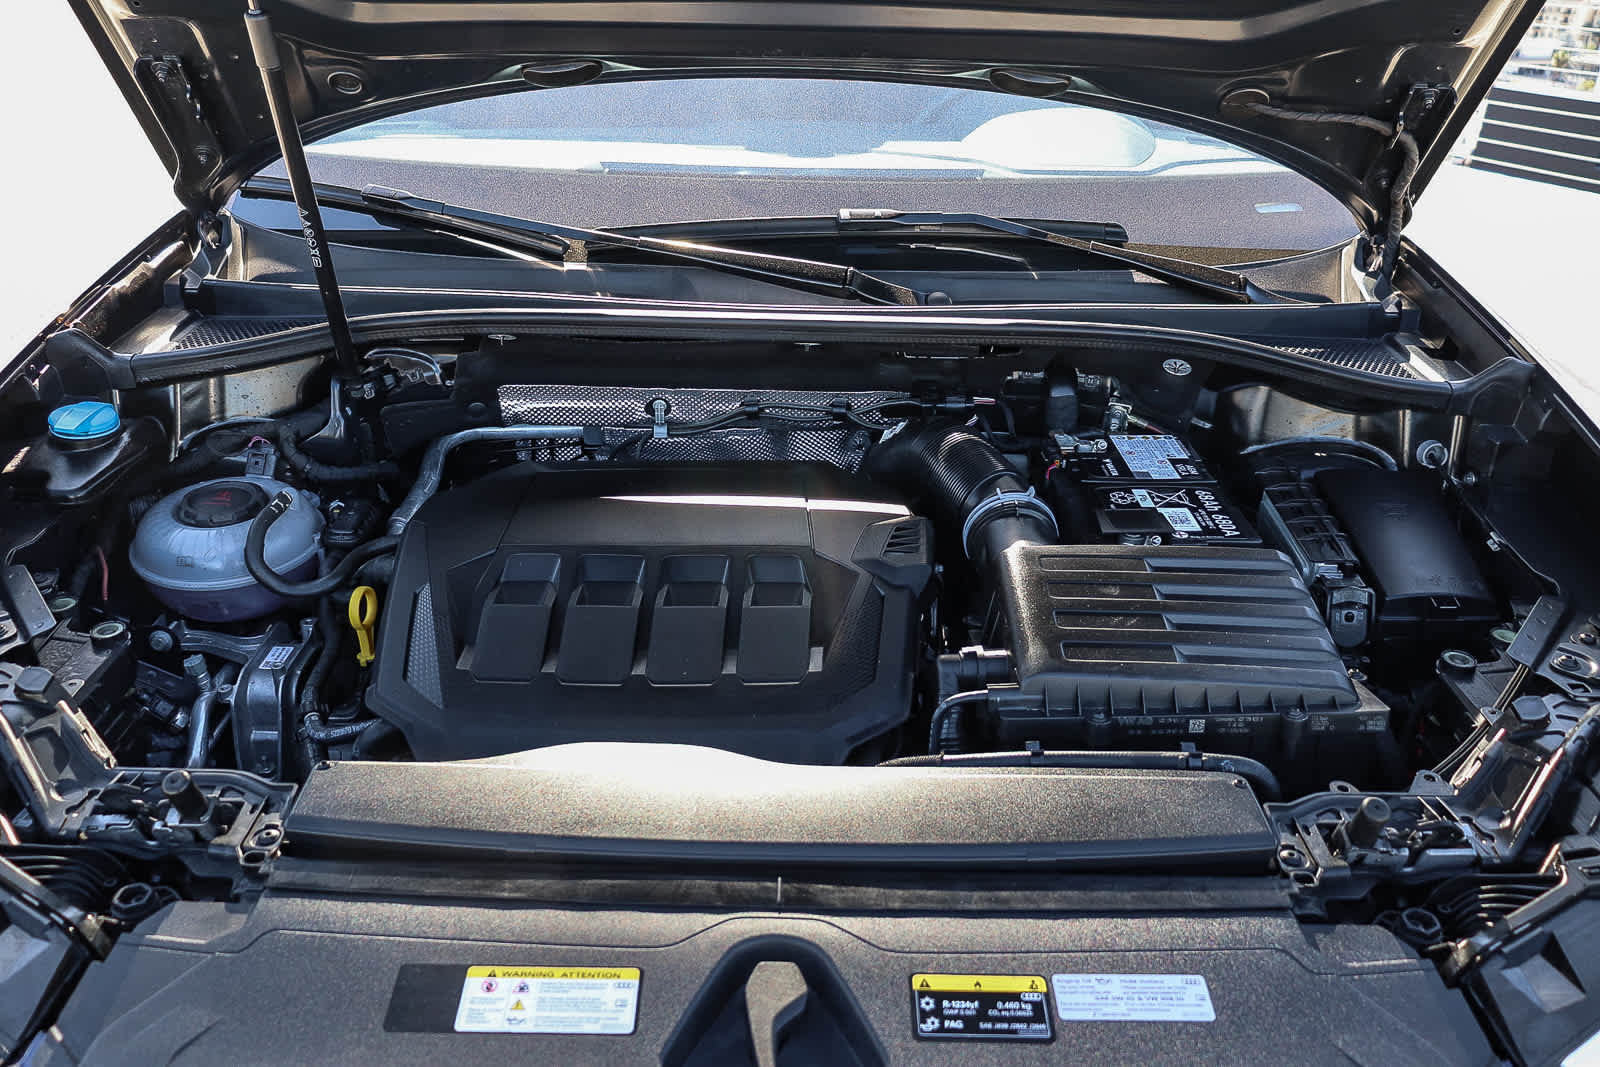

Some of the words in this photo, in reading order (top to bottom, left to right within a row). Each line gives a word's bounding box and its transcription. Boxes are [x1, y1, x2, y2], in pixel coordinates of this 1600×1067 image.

[1195, 490, 1223, 512] 68Ah
[1212, 514, 1241, 537] 680A
[560, 971, 621, 979] ATTENTION
[944, 1020, 964, 1029] PAG
